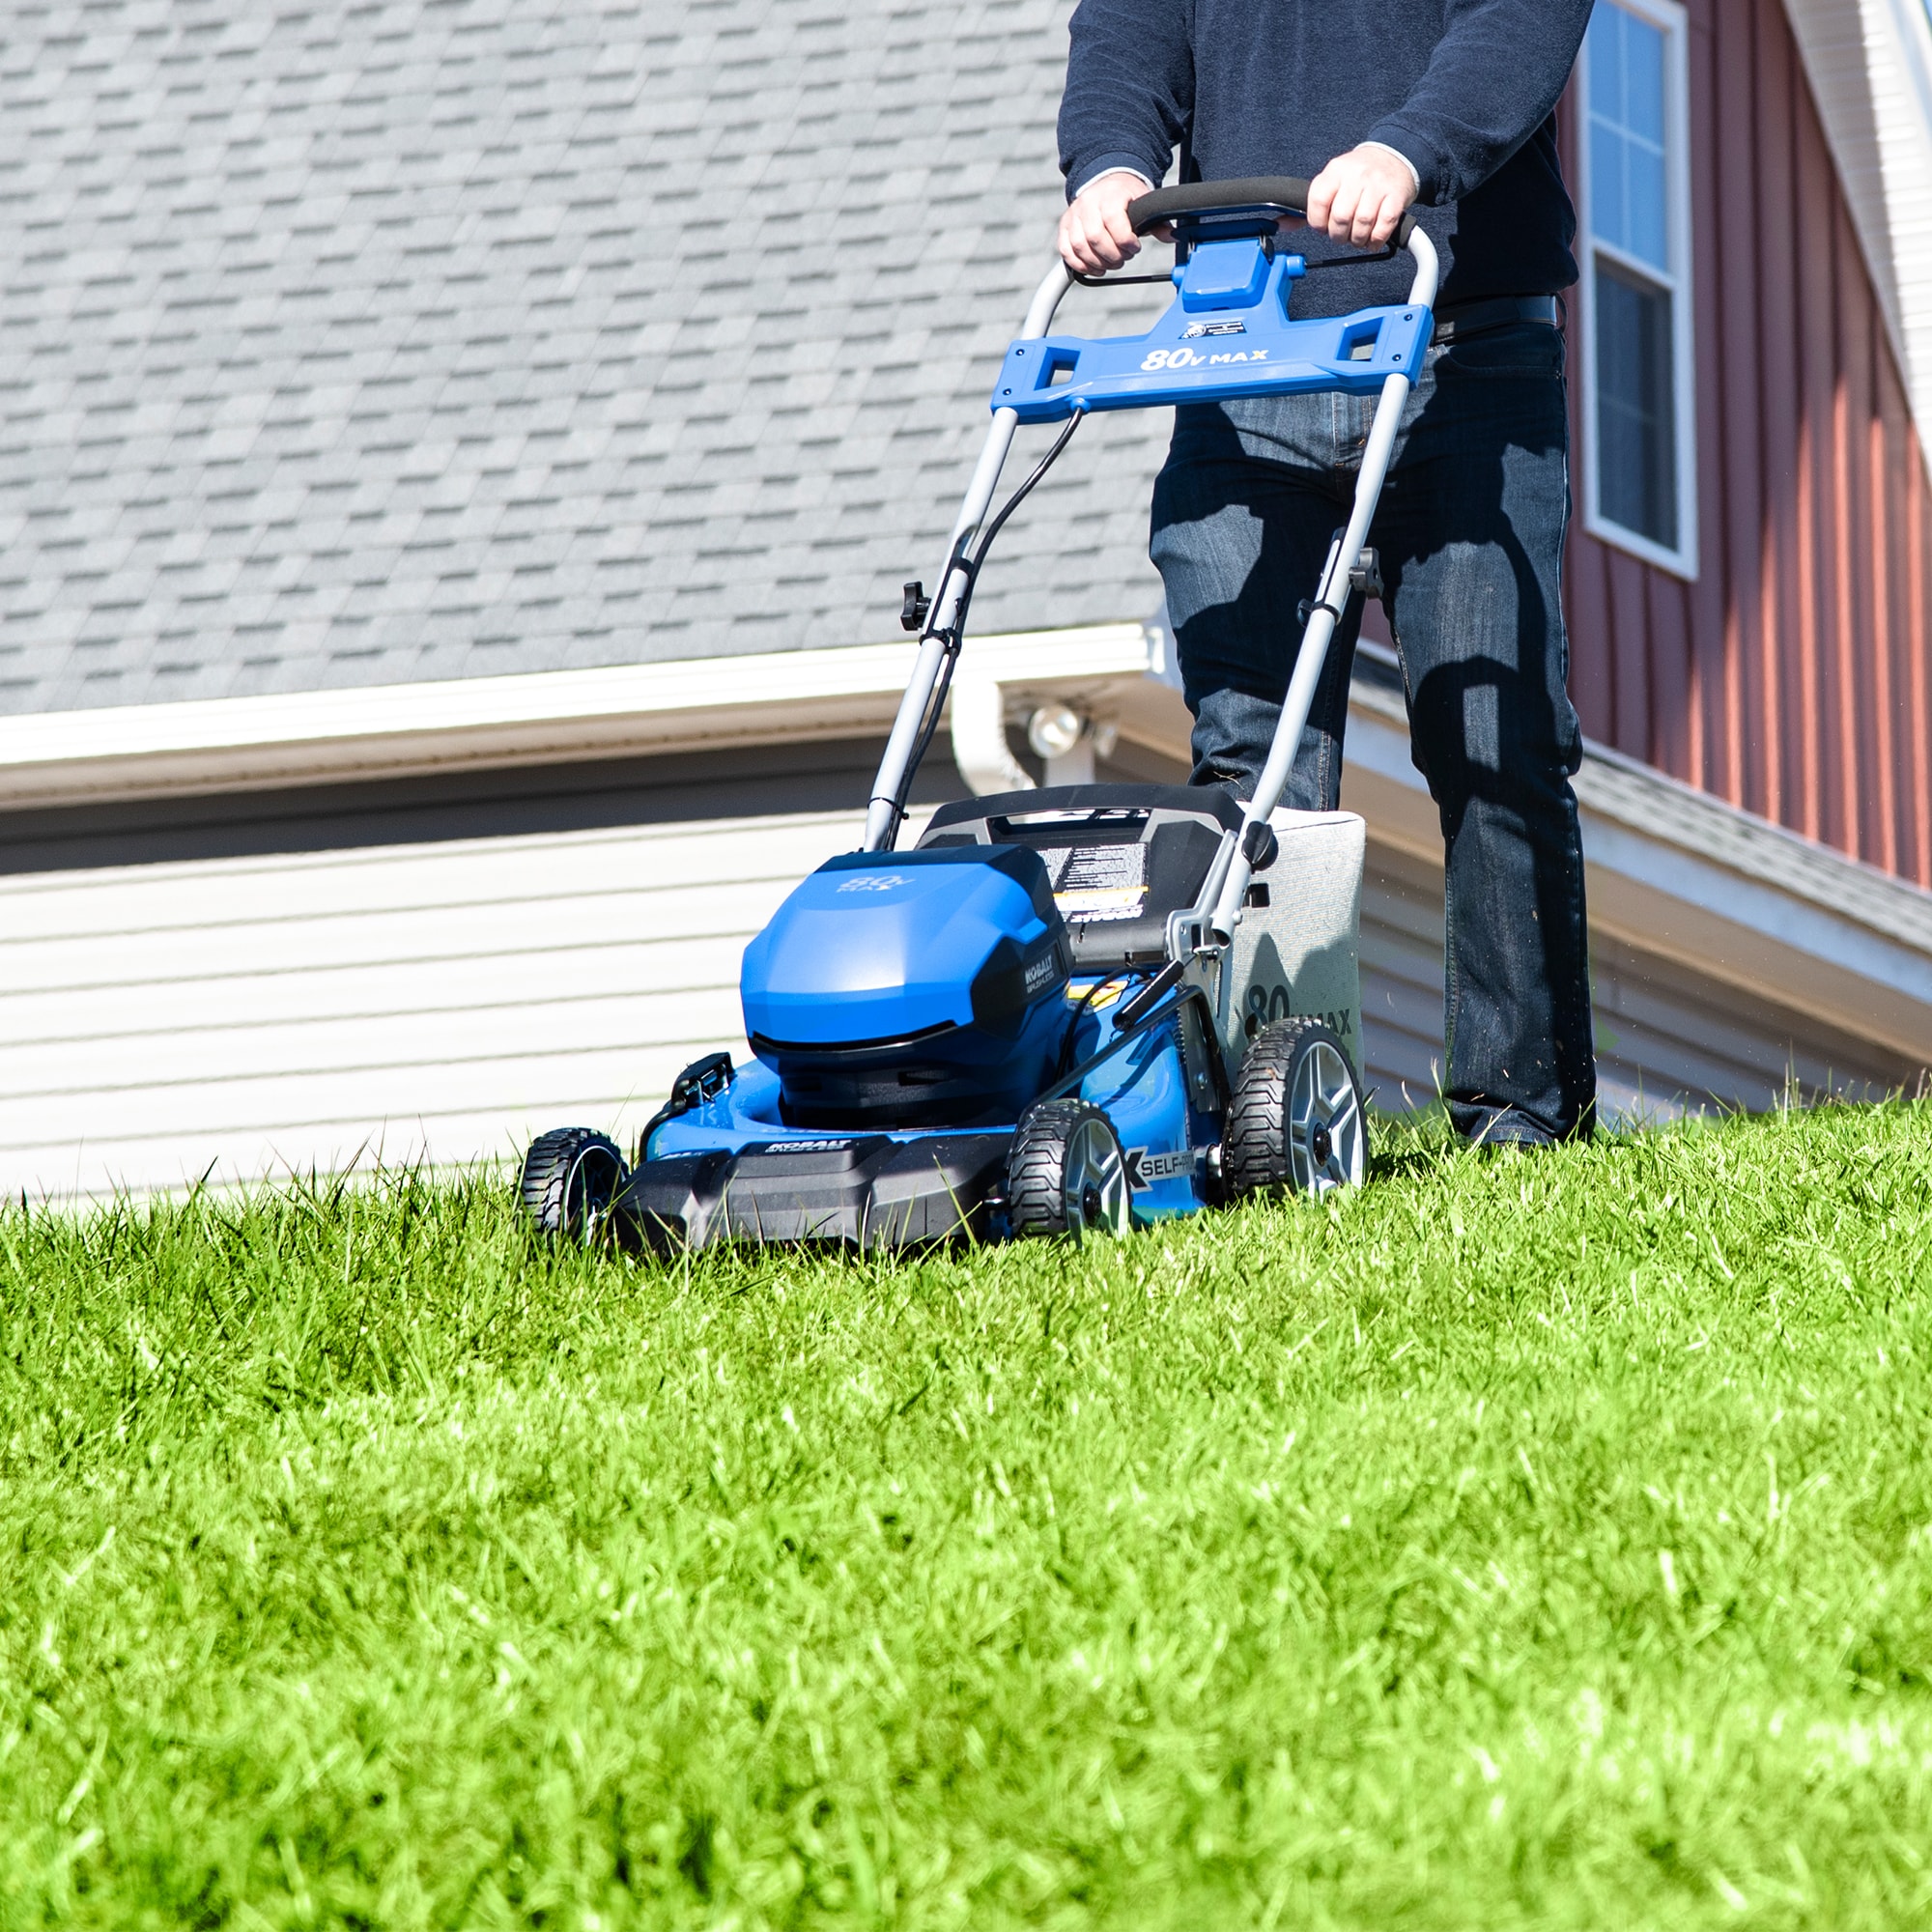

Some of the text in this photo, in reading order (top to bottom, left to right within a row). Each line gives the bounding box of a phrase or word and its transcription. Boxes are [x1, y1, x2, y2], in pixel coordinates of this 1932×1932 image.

[1208, 350, 1269, 364] MAX
[1025, 954, 1052, 984] KOBALT
[767, 1139, 852, 1150] KOBALT
